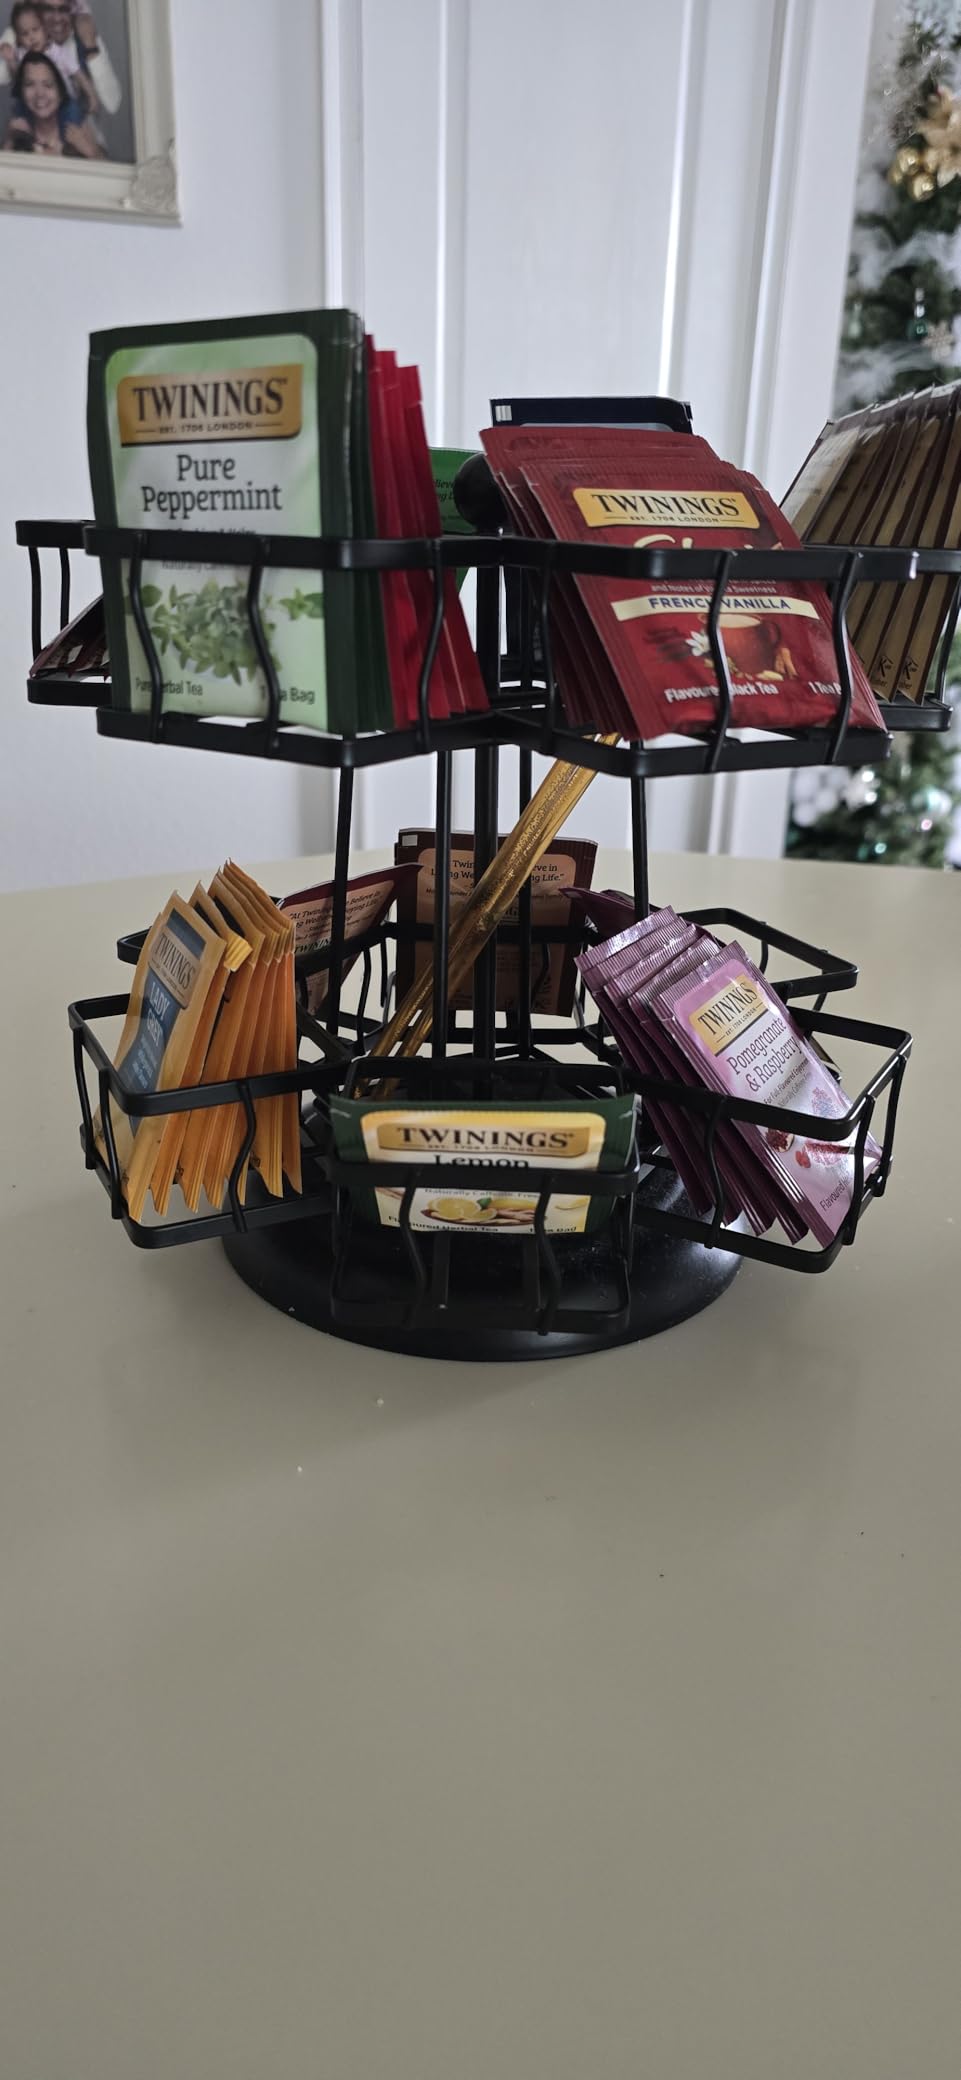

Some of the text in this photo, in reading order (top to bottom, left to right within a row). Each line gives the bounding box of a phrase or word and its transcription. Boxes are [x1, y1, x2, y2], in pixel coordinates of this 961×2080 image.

[132, 378, 286, 422] TWININGS
[207, 421, 253, 432] LONDON
[176, 454, 236, 482] Pure
[141, 482, 283, 520] Peppermint
[591, 494, 741, 517] TWININGS
[677, 516, 720, 524] LONDON
[187, 681, 204, 696] Tea
[290, 687, 316, 705] Bag
[663, 685, 719, 703] Flavoure
[757, 681, 780, 695] Tea
[814, 681, 836, 694] Tea
[154, 932, 195, 991] TWININGS
[150, 981, 171, 1021] LADY
[697, 982, 758, 1036] TWININGS
[146, 1007, 163, 1048] GREY
[726, 1017, 787, 1076] Pomegranate
[745, 1072, 761, 1093] &
[753, 1036, 802, 1084] Raspberry
[396, 1127, 570, 1149] TWININGS
[820, 1180, 846, 1212] Flavoured
